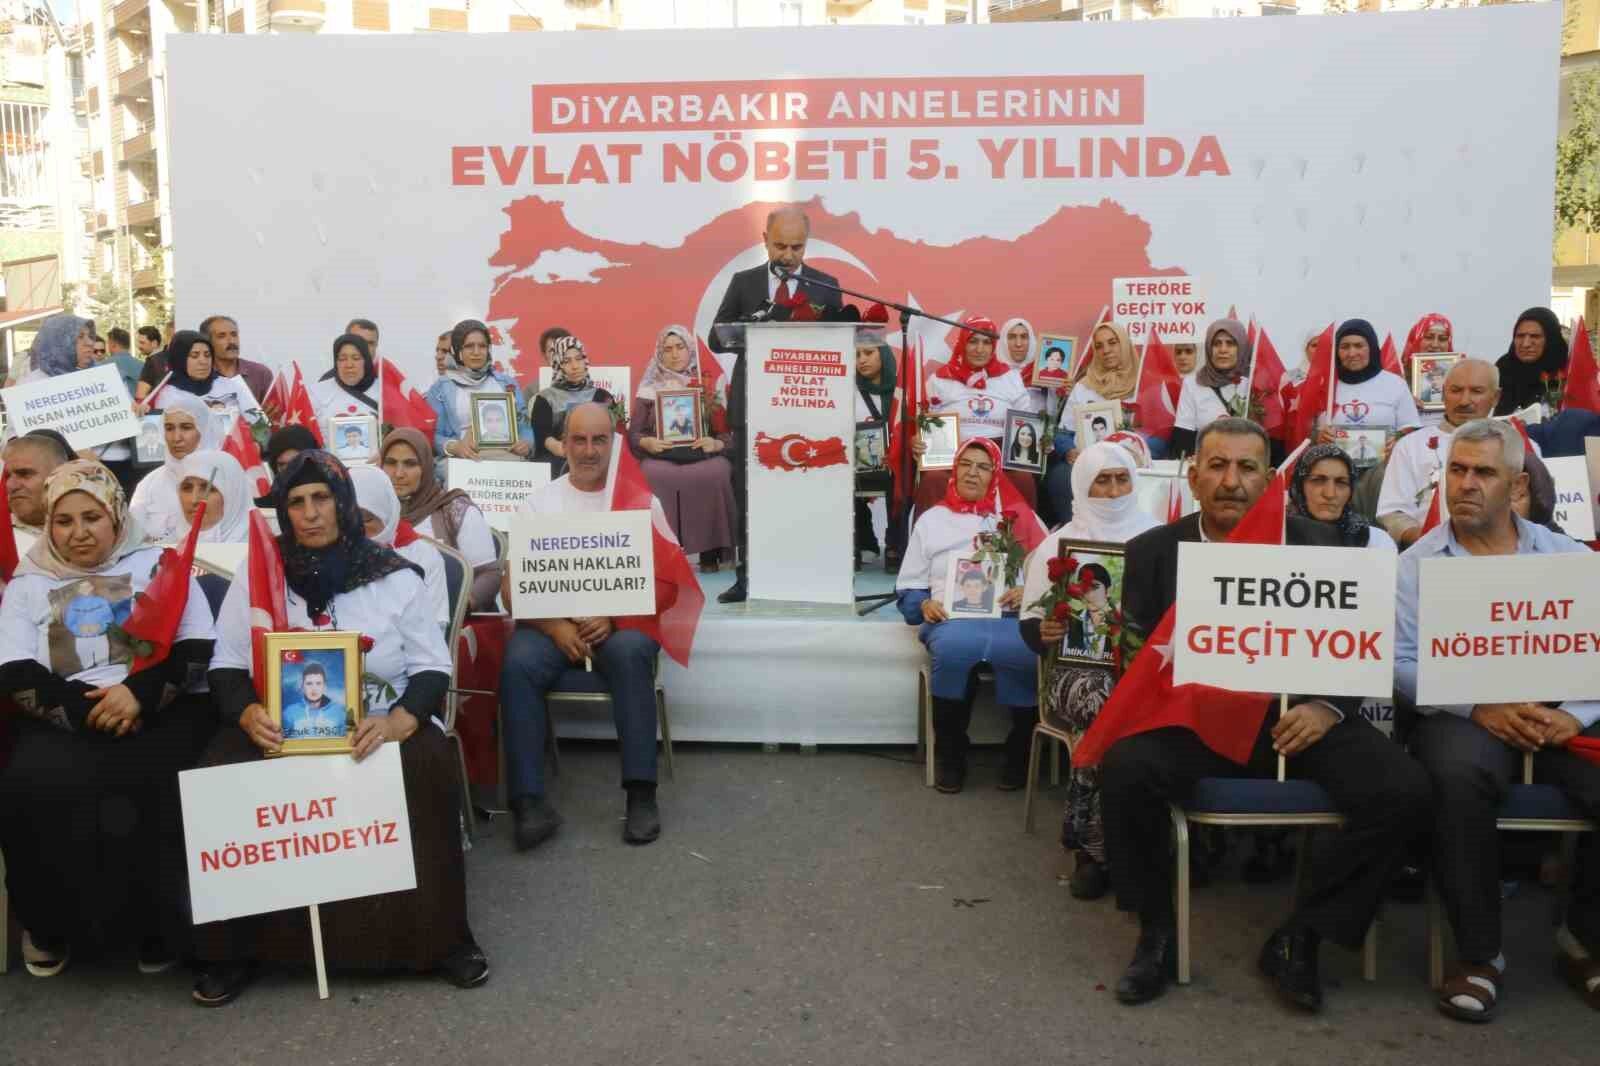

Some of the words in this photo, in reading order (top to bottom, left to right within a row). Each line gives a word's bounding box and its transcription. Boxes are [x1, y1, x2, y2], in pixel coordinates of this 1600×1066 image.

[451, 143, 642, 186] EVLAT
[663, 132, 888, 184] NÖBETİ
[906, 138, 959, 181] 5.
[977, 135, 1231, 180] YILINDA
[1126, 280, 1192, 296] TERÖRE
[1117, 300, 1166, 319] GEÇİT
[1171, 302, 1206, 315] YOK
[784, 376, 826, 385] EVLAT
[24, 383, 107, 411] NEREDESİNİZ
[22, 409, 63, 427] İNSAN
[66, 395, 120, 417] HAKLARI
[467, 478, 532, 488] ANNELERDEN
[530, 531, 631, 551] NEREDESİNİZ
[522, 557, 569, 573] İNSAN
[573, 555, 641, 571] HAKLARI
[519, 577, 646, 594] SAVUNUCULARI?
[1214, 572, 1358, 609] TERÖRE
[1490, 600, 1574, 622] EVLAT
[1187, 620, 1296, 664] GEÇİT
[1304, 628, 1383, 660] YOK
[256, 797, 338, 828] EVLAT
[200, 820, 399, 872] NÖBETİNDEYİZ
